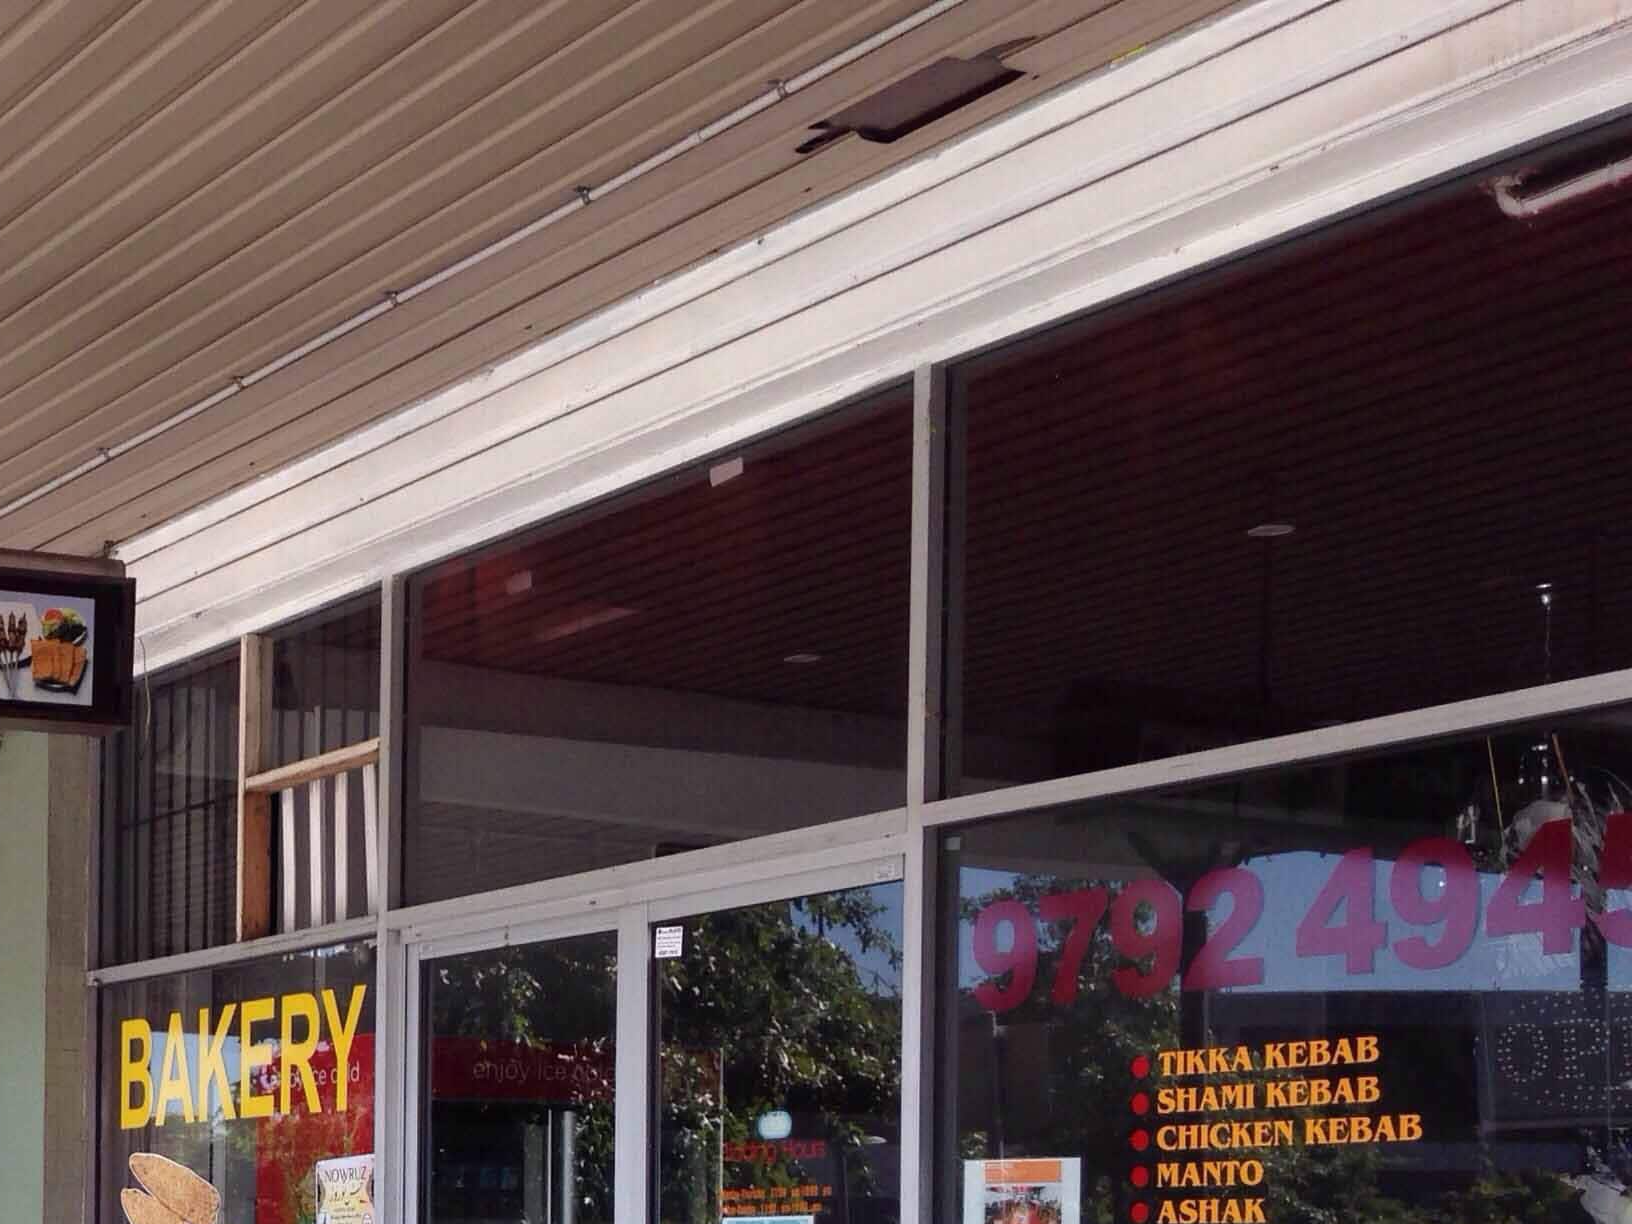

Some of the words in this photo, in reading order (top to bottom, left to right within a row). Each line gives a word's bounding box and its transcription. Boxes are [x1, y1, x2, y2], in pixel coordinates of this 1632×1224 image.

[973, 868, 1265, 1013] 9792
[120, 984, 367, 1130] BAKERY
[1158, 1045, 1254, 1077] TIKKA
[1264, 1035, 1380, 1070] KEBAB
[1156, 1083, 1256, 1114] SHAMI
[1265, 1076, 1381, 1108] KEBAB
[1156, 1119, 1295, 1151] CHICKEN
[1305, 1114, 1423, 1145] KEBAB
[1156, 1160, 1265, 1188] MANTO
[1156, 1198, 1267, 1224] ASHAK
